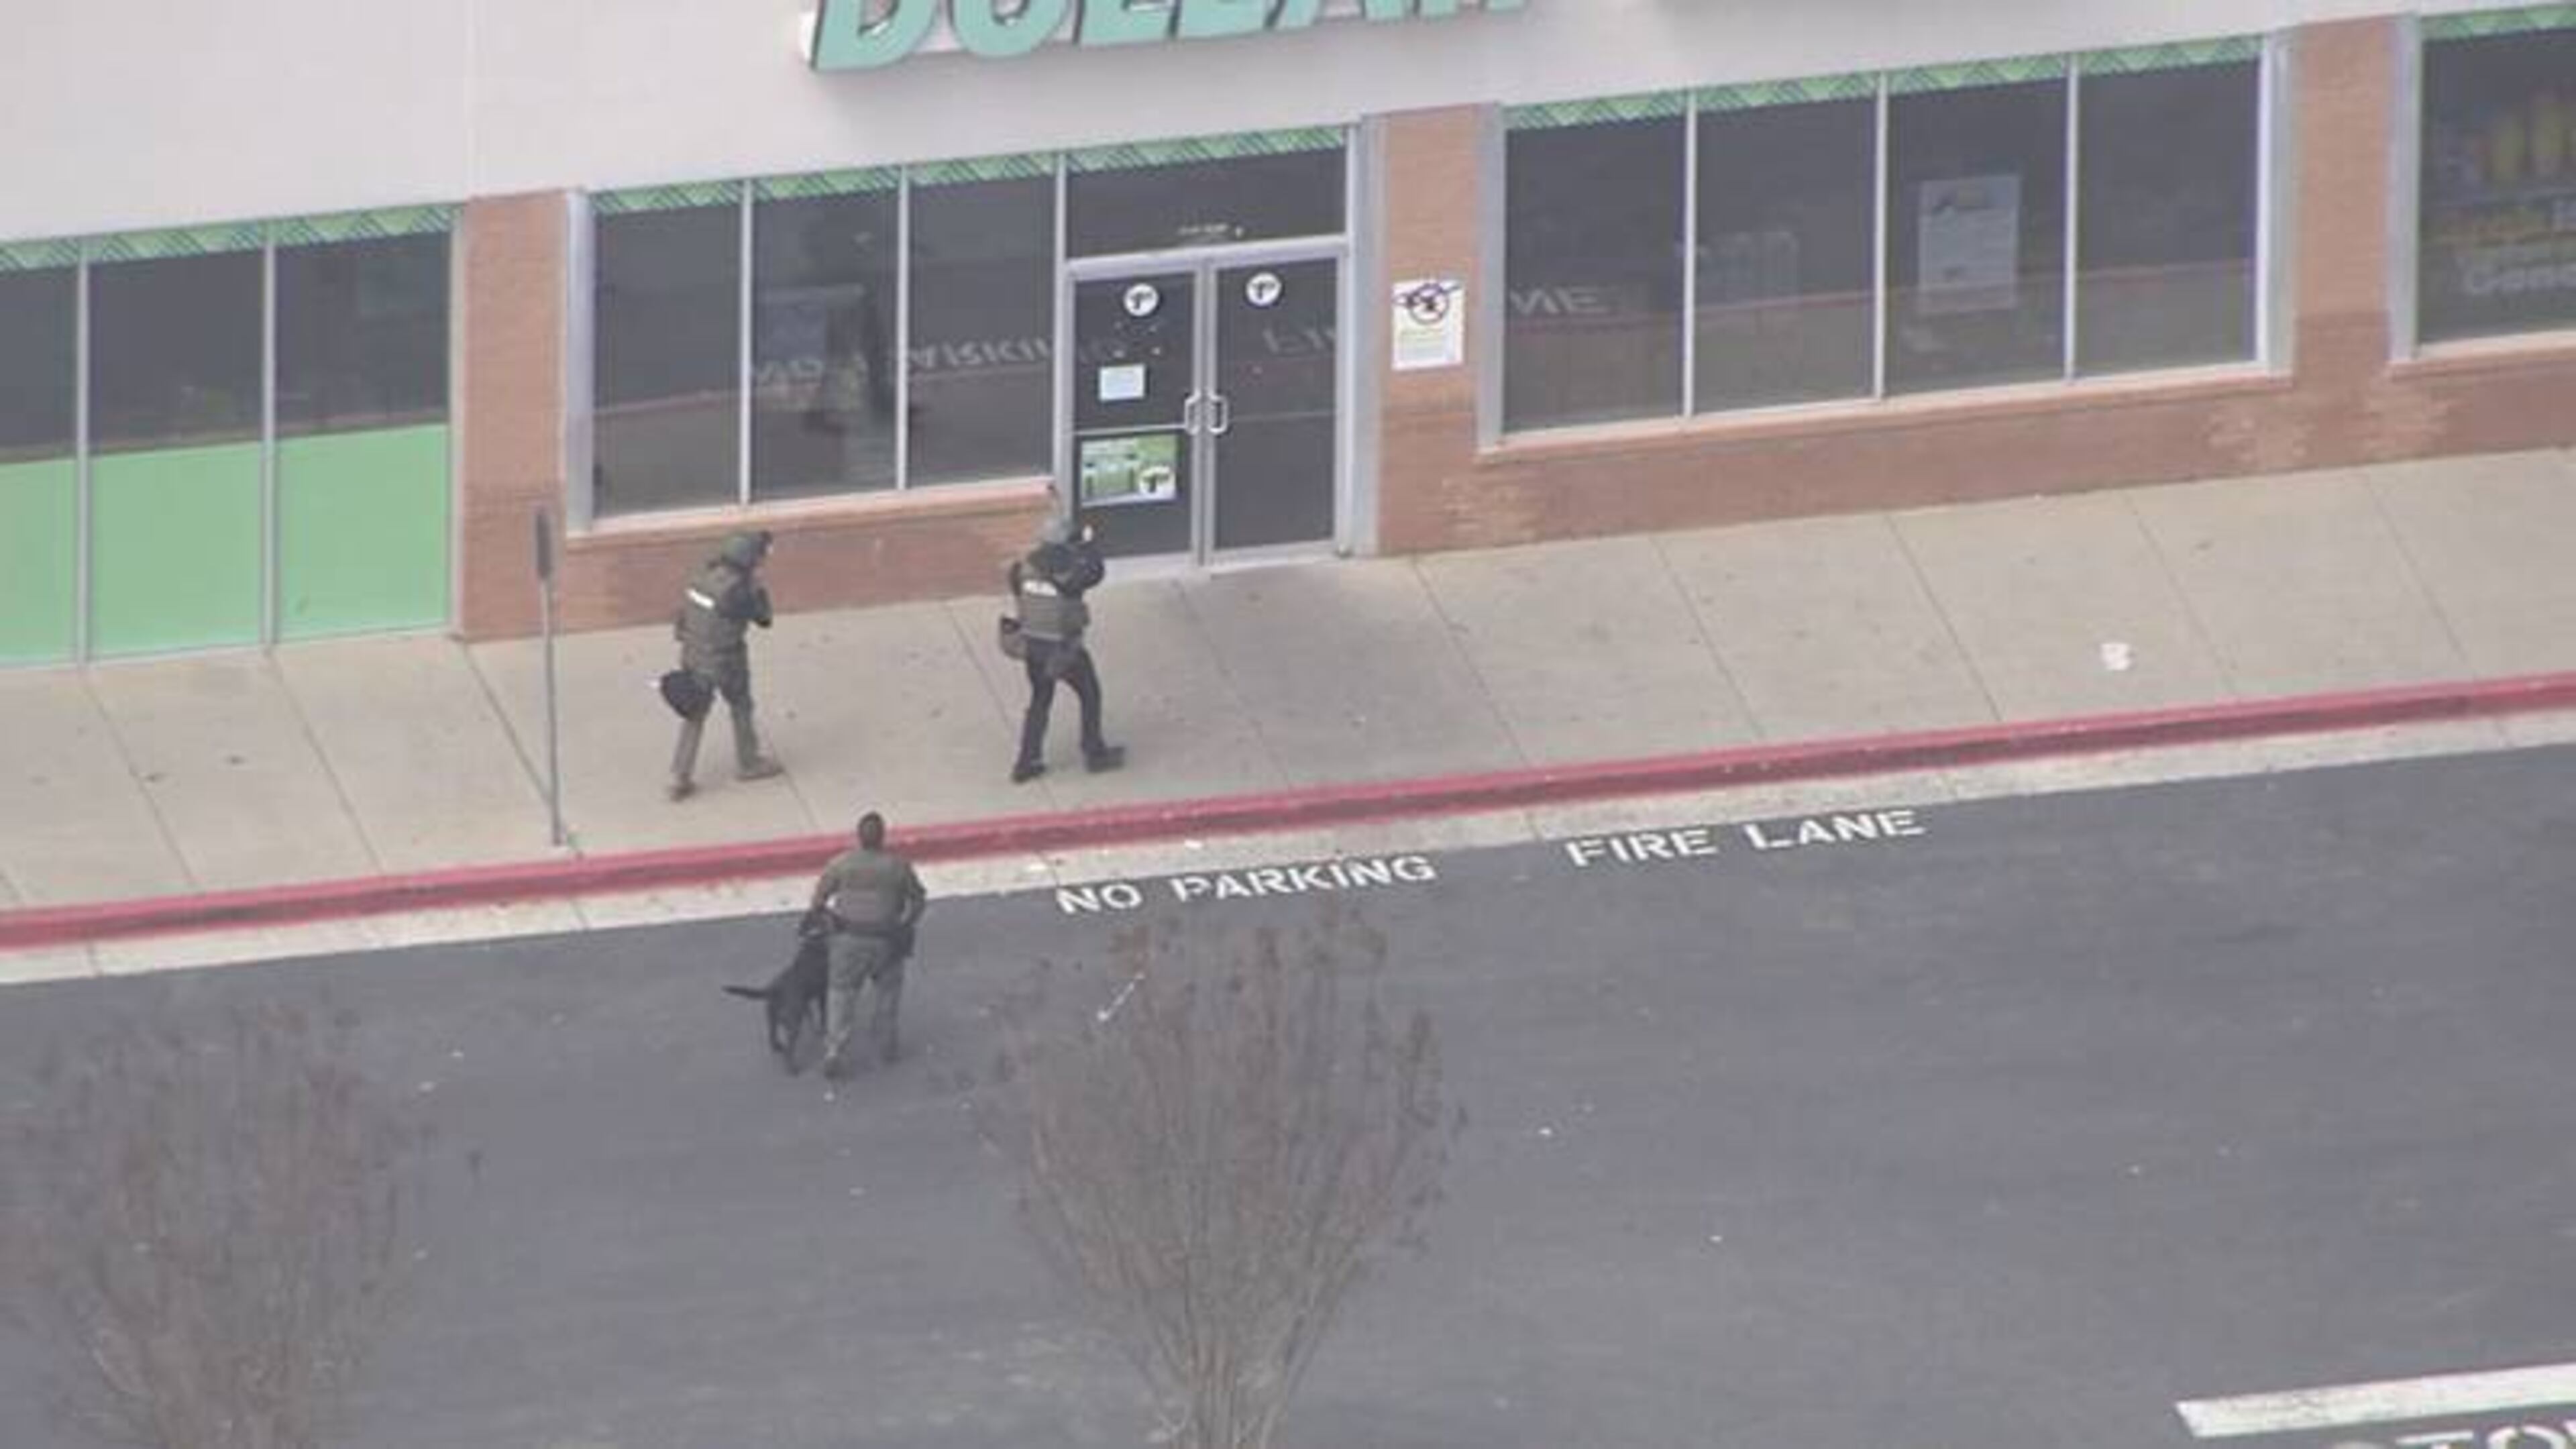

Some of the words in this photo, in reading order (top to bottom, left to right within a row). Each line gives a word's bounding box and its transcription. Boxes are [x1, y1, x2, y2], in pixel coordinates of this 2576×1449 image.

[811, 0, 1526, 70] DOLL
[1564, 828, 1718, 866] FIRE
[1744, 810, 1924, 849] LANE
[1056, 883, 1142, 914] NO
[1170, 855, 1436, 902] PARKING
